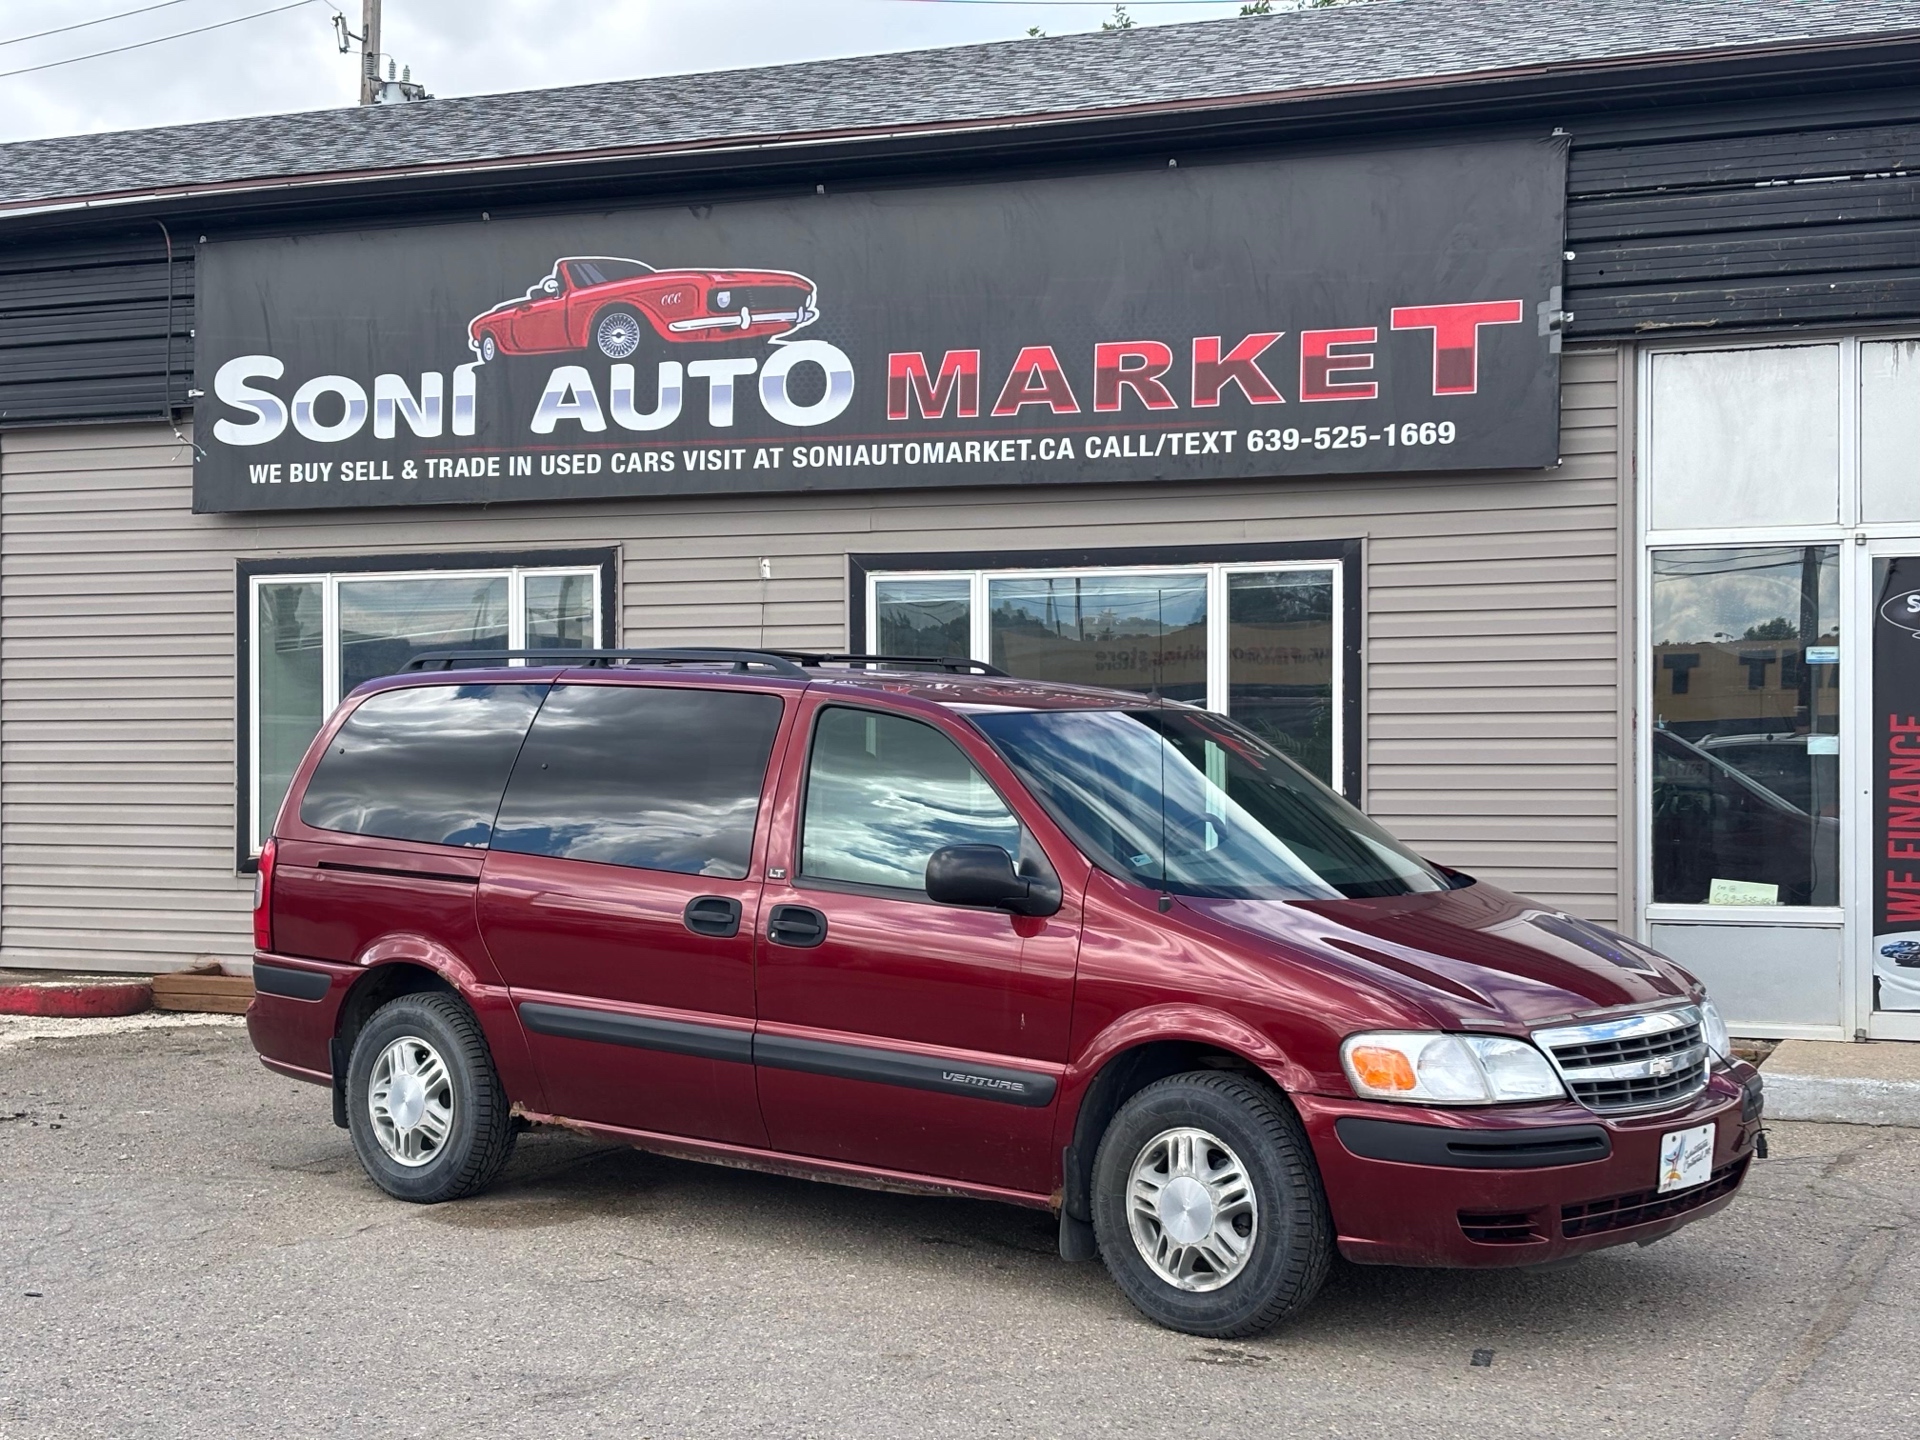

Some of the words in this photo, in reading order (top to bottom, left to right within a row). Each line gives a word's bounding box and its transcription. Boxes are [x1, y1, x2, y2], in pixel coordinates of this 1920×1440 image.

[213, 354, 480, 446] SONI
[530, 339, 855, 434] AUTO
[886, 299, 1524, 420] MARKET
[248, 463, 281, 484] WE
[289, 461, 333, 482] BUY
[340, 459, 393, 481] SELL
[401, 459, 418, 479] &
[425, 456, 501, 478] TRADE
[509, 455, 531, 476] IN
[540, 453, 601, 475] USED
[610, 450, 675, 473] CARS
[682, 448, 746, 470] VISIT
[752, 447, 783, 469] AT
[792, 437, 1074, 467] SONIAUTOMARKET.CA
[1085, 430, 1237, 459] CALL/TEXT
[1246, 421, 1456, 452] 639-525-1669
[1888, 714, 1920, 859] FINANCE
[769, 868, 784, 878] LT
[1886, 870, 1920, 922] WE
[942, 1071, 1025, 1093] VENTURE
